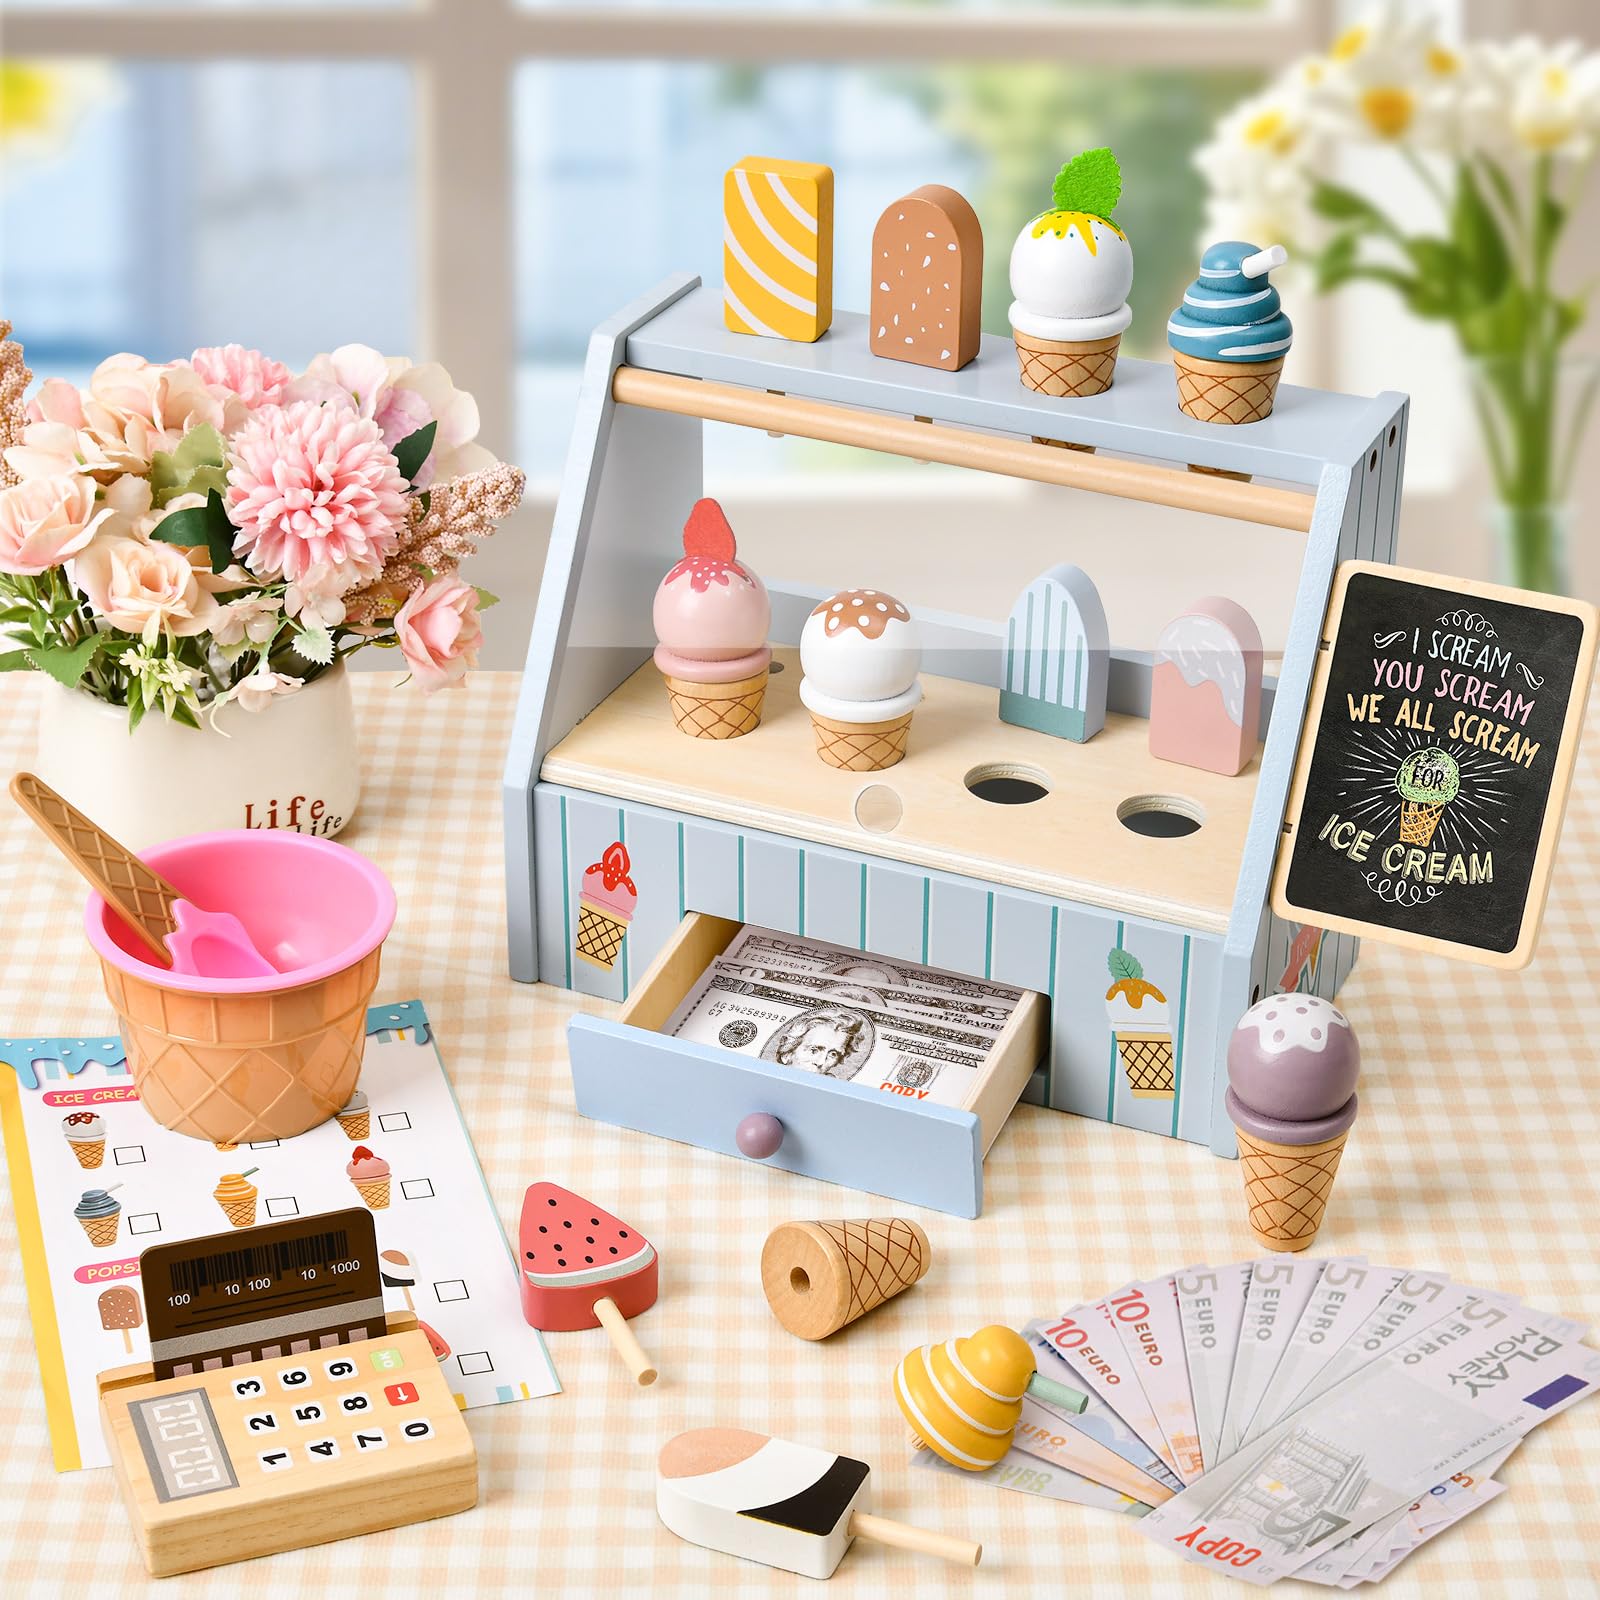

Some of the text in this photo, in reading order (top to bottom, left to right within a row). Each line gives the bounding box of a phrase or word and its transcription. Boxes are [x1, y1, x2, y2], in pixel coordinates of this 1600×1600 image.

[1412, 627, 1513, 678] I SCREAM
[1373, 658, 1536, 727] YOU SCREAM
[1347, 693, 1542, 769] WE ALL SCREAM
[1411, 766, 1444, 792] FOR
[245, 795, 326, 830] Life
[1318, 813, 1495, 885] ICE CREAM
[53, 1089, 137, 1104] ICE CREA
[87, 1261, 141, 1279] POPSI
[167, 1259, 361, 1307] 100 10 100 10 1000
[1178, 1273, 1218, 1295] 5
[1254, 1264, 1294, 1285] 5
[1324, 1264, 1368, 1289] 5
[1399, 1274, 1446, 1303] 5
[1111, 1289, 1150, 1322] 10
[1195, 1297, 1217, 1349] EURO
[1256, 1288, 1281, 1341] EURO
[1309, 1290, 1347, 1345] EURO
[1363, 1301, 1417, 1351] EURO
[1462, 1298, 1508, 1329] 5
[1045, 1317, 1088, 1348] 10
[1134, 1322, 1163, 1366] EURO
[1403, 1323, 1472, 1365] EURO
[1078, 1346, 1121, 1385] EURO
[1447, 1326, 1540, 1385] MONEY
[1464, 1335, 1563, 1399] PLAY
[236, 1380, 287, 1465] 1 2 3
[283, 1370, 334, 1457] 4 5 6
[329, 1361, 383, 1449] 7 8 9
[404, 1421, 429, 1437] 0
[1017, 1420, 1067, 1447] URO
[1263, 1497, 1352, 1548] 5
[1174, 1525, 1262, 1567] COPY
